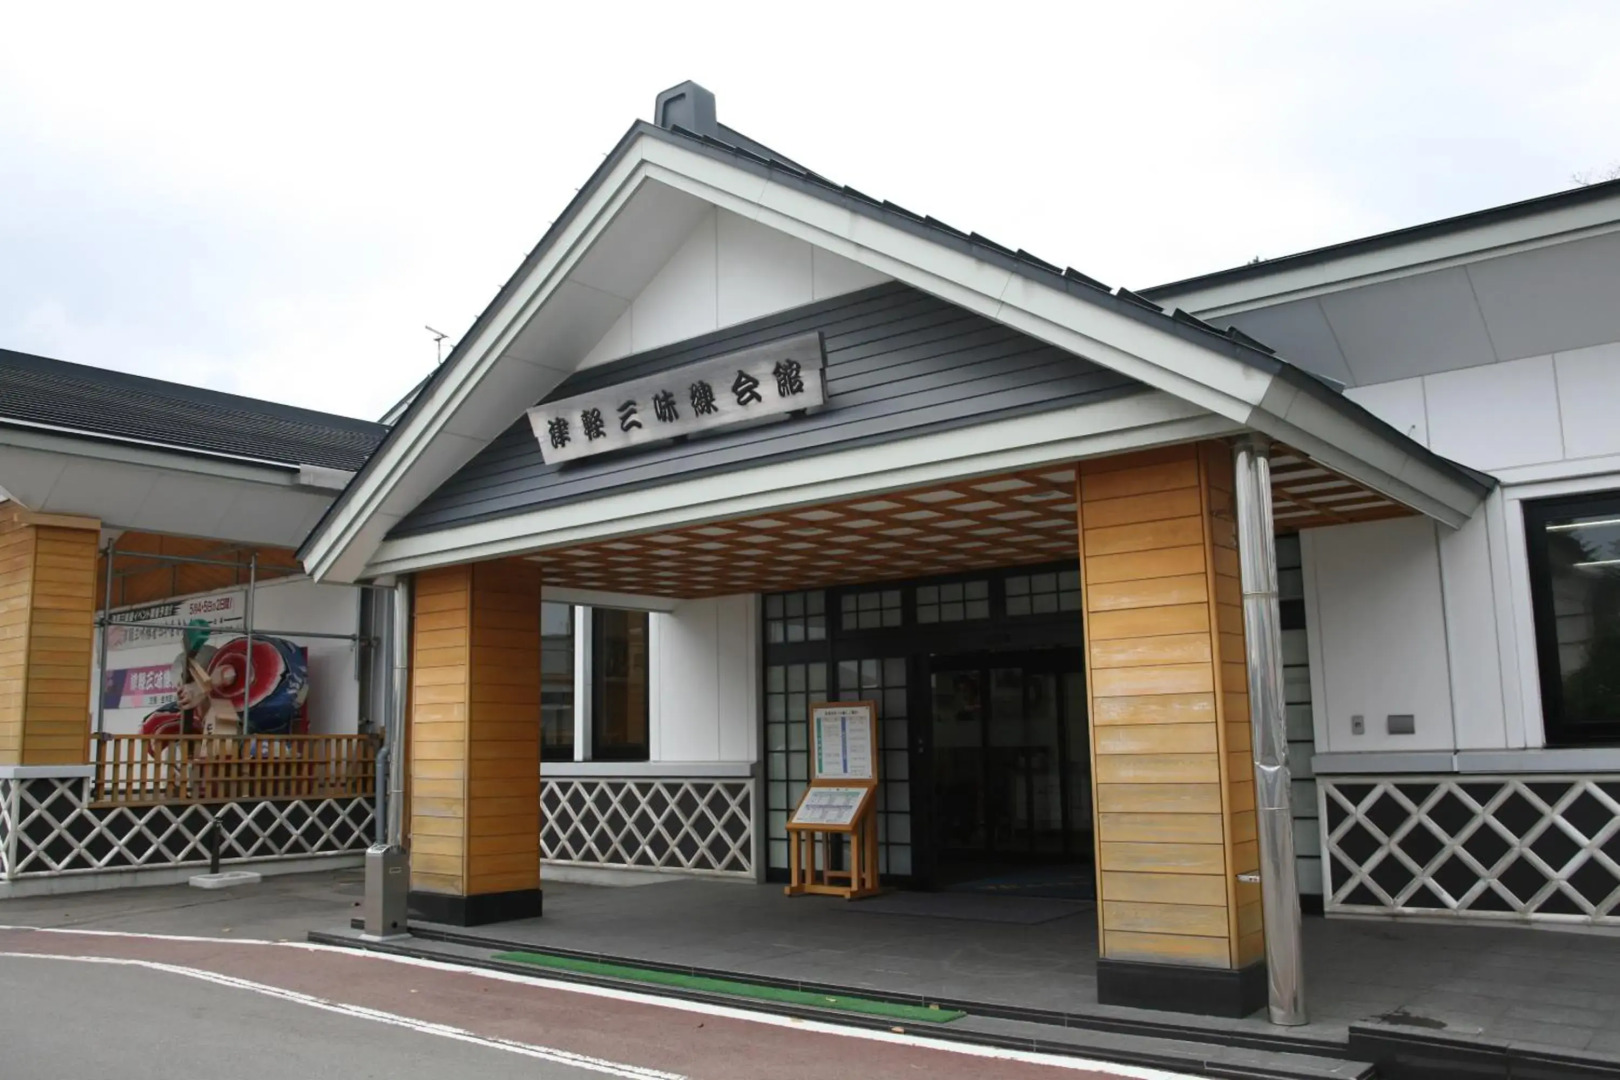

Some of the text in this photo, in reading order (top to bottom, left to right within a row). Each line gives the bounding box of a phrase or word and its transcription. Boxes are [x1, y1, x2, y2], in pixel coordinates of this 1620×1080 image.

[547, 357, 806, 450] 津軽三味線会館
